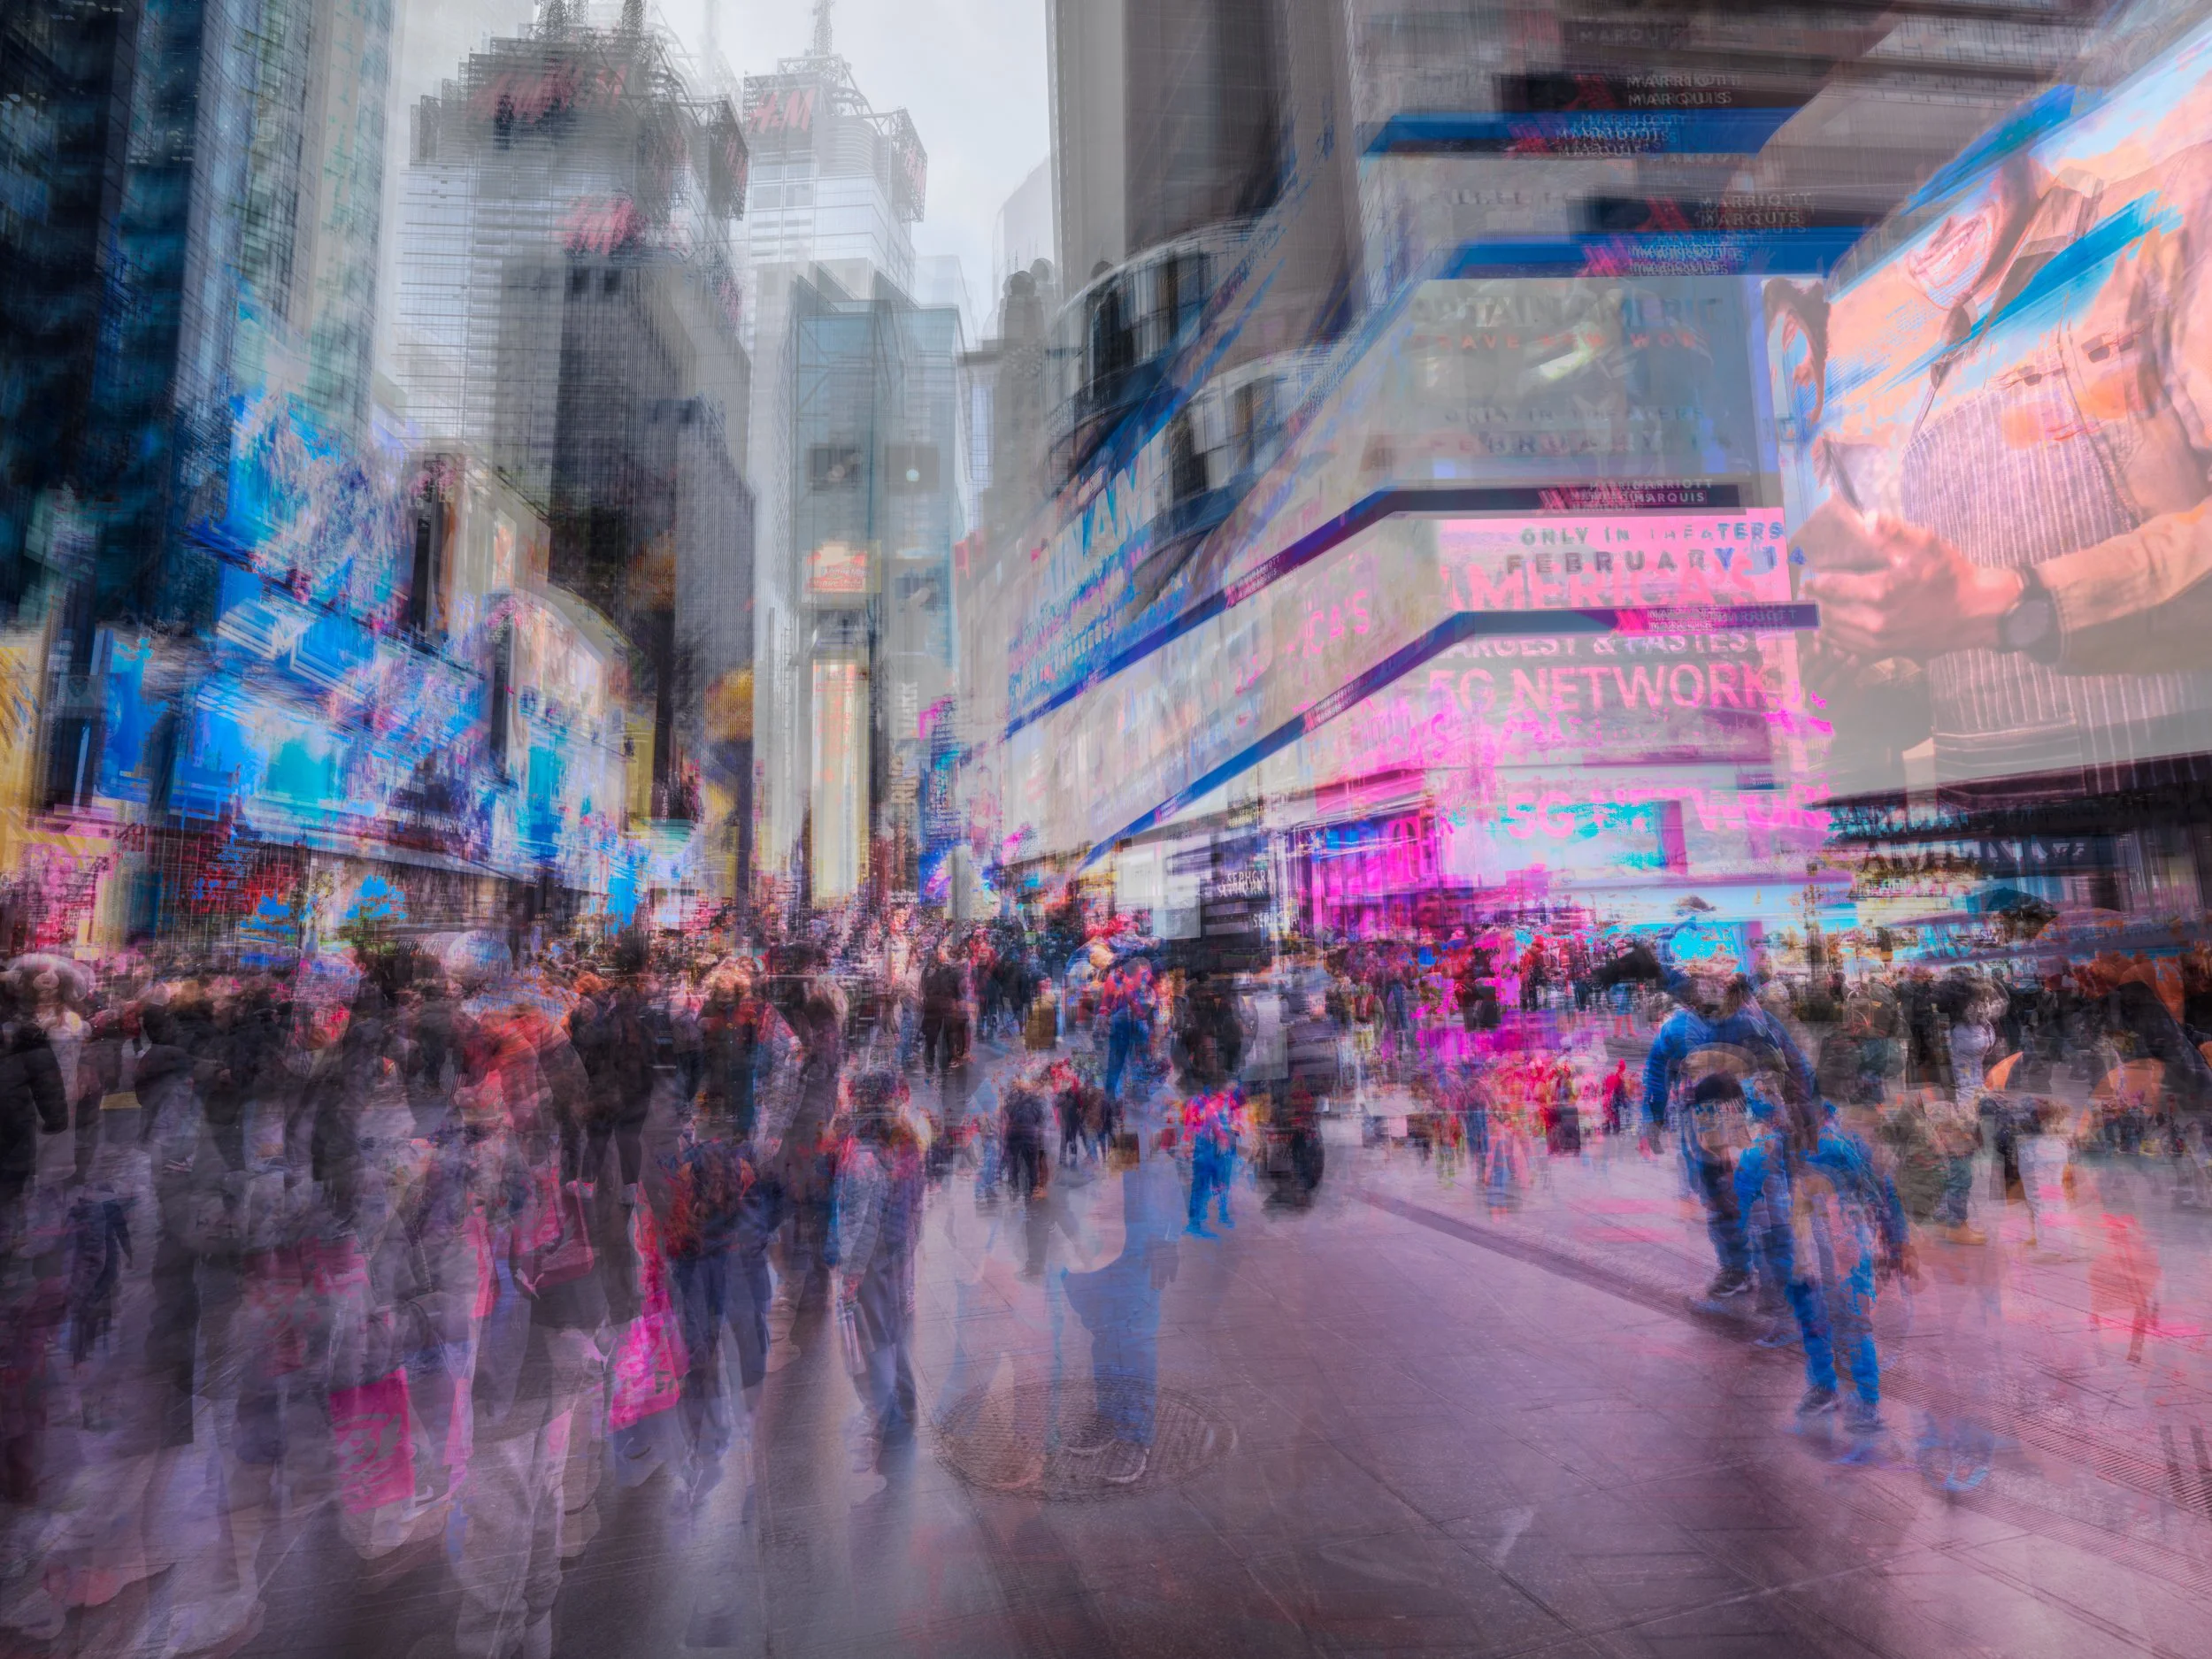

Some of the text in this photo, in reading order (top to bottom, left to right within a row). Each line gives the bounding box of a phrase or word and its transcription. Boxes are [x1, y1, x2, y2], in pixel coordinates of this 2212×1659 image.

[1701, 211, 1801, 225] MARQUIS
[1521, 526, 1589, 546] ONLY
[1604, 526, 1630, 543] IN
[1507, 546, 1735, 576] FEBRUARY
[1429, 661, 1778, 710] 5G NETWORK
[1508, 791, 1577, 840] 5G
